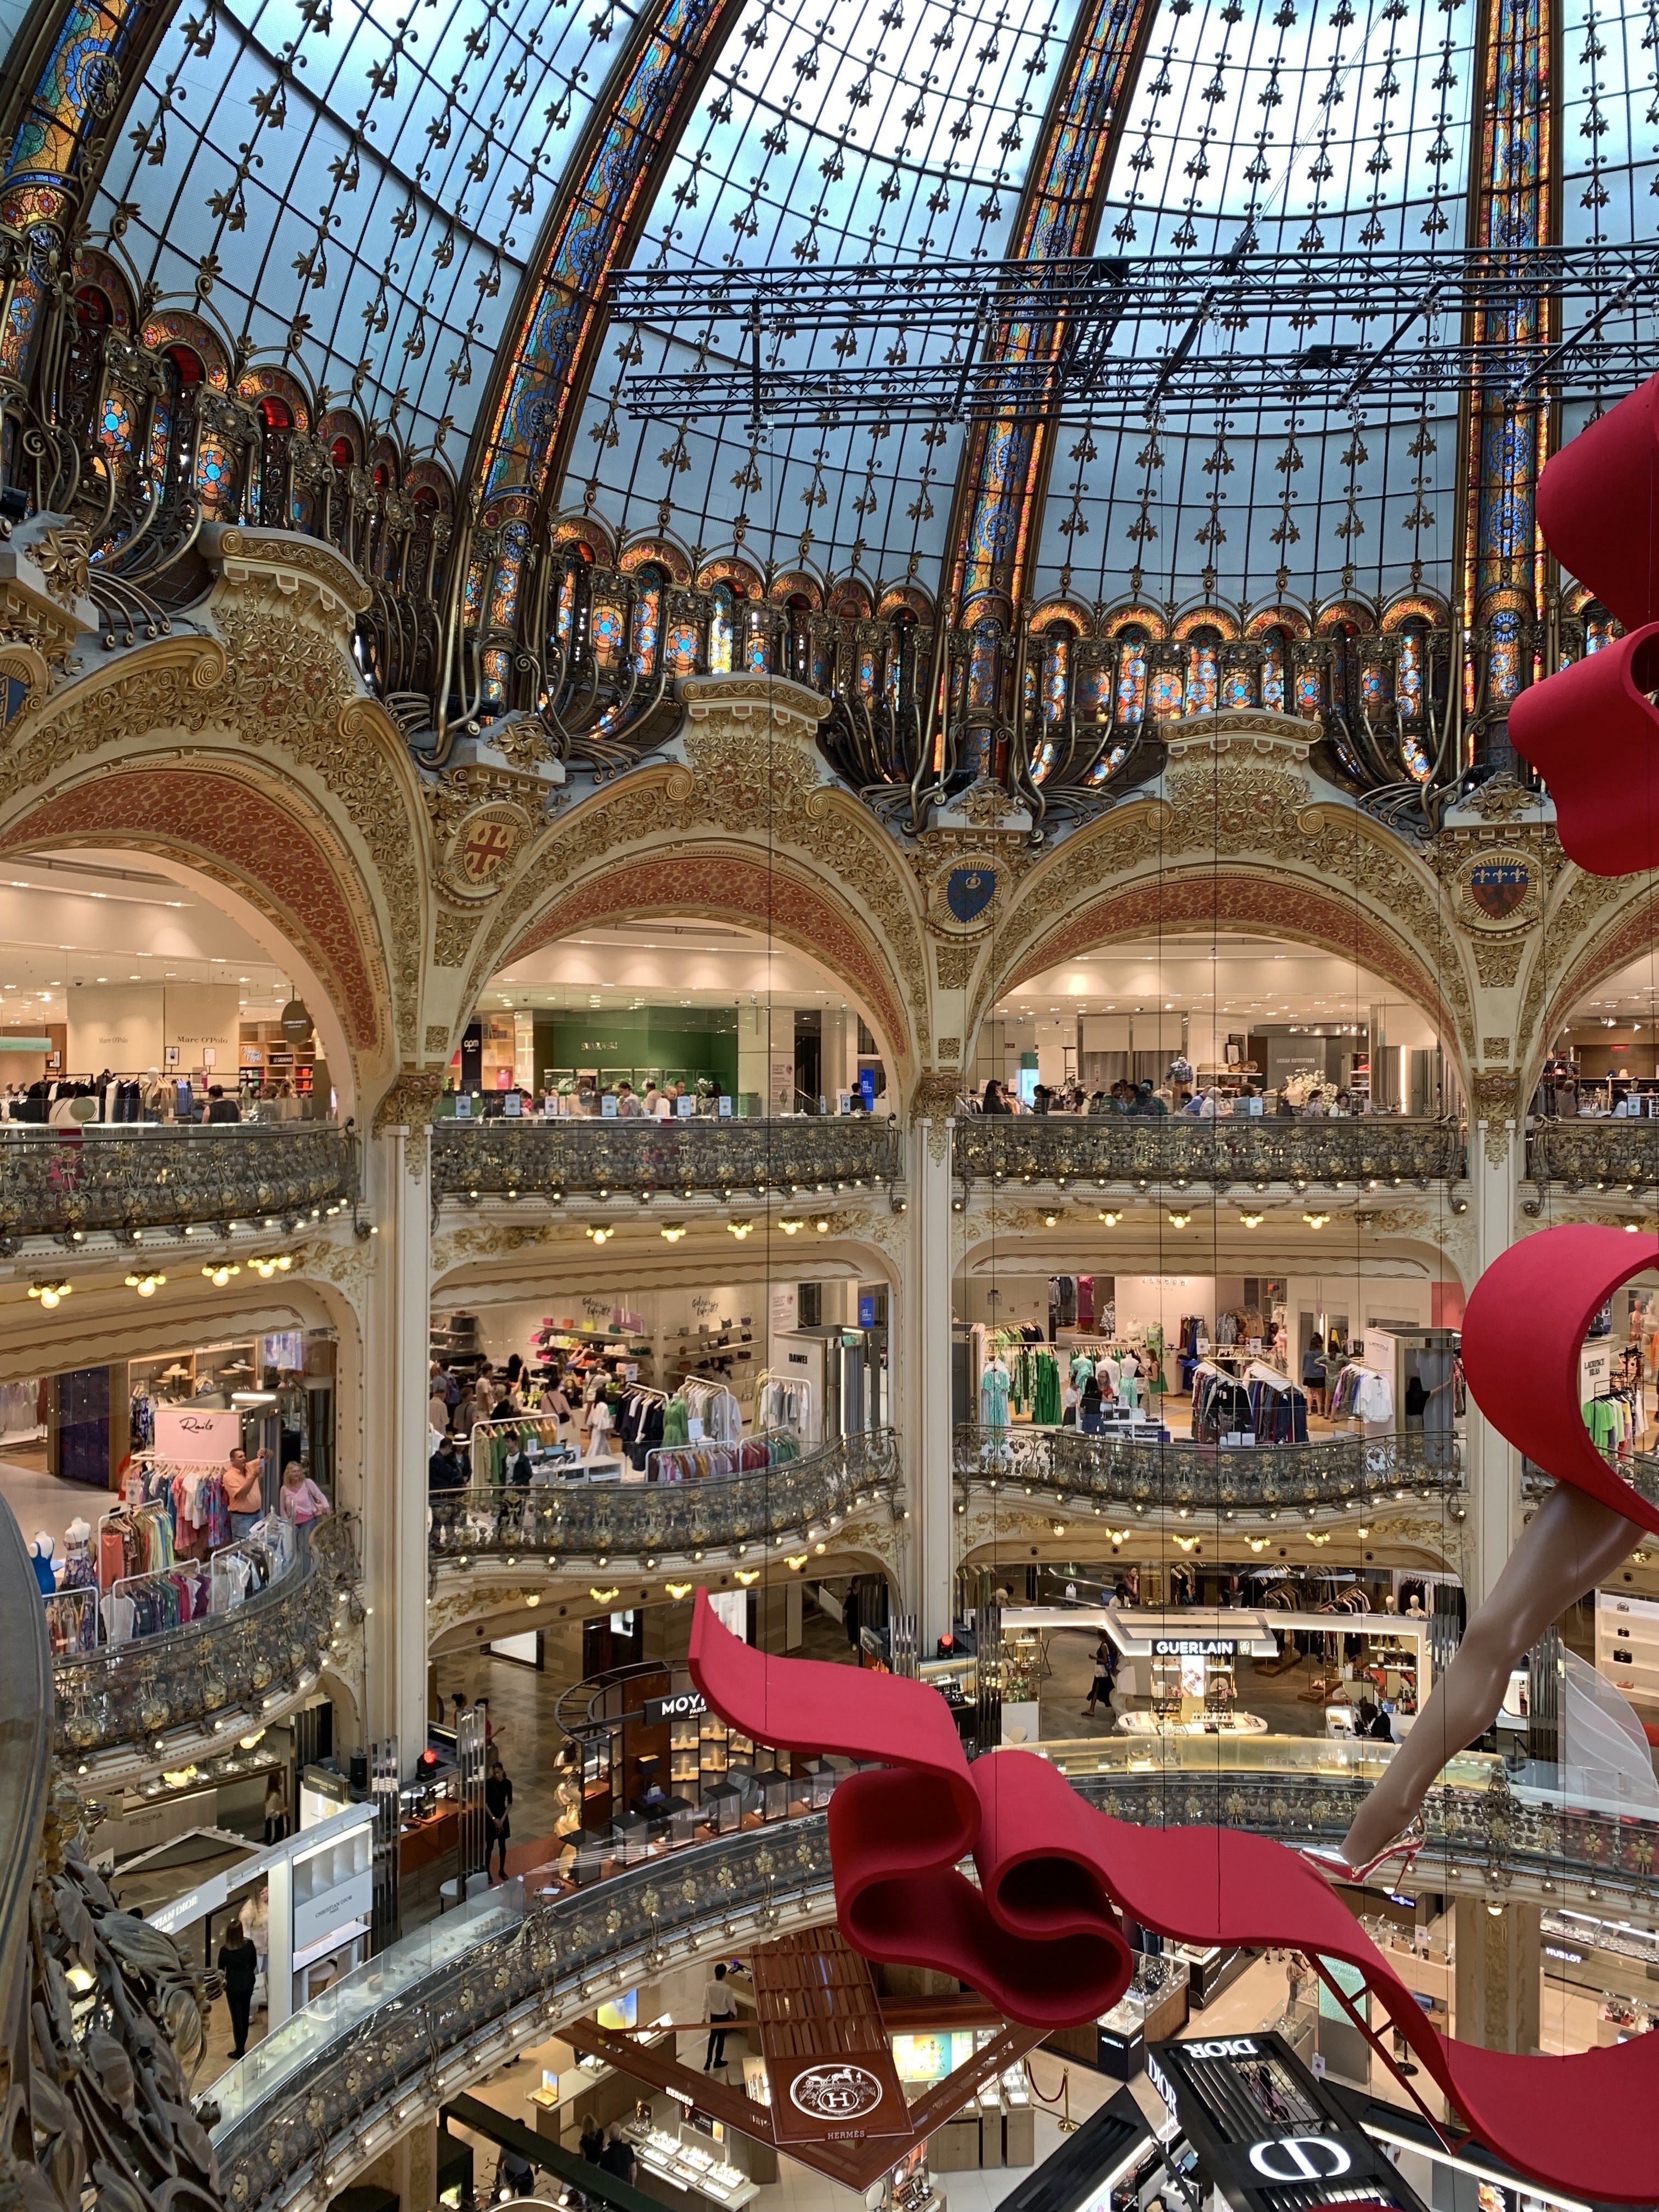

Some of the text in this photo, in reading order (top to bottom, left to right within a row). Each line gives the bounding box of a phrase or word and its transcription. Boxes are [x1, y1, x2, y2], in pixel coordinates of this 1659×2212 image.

[464, 1039, 479, 1050] apm
[581, 1042, 618, 1051] SWAROVSKI
[788, 1353, 808, 1364] DAWEI
[179, 1417, 213, 1434] Rails
[1156, 1641, 1234, 1655] GUERLAIN
[689, 1706, 707, 1714] PARIS
[308, 1775, 338, 1792] CHRISTIAN DIOR
[129, 1813, 163, 1826] MESSIKA
[150, 1895, 199, 1929] TIAN DIOR
[315, 1895, 352, 1918] CHRISTIAN DIOR
[1546, 1946, 1582, 1963] HUBLOT
[1183, 2039, 1259, 2058] DIOR
[1148, 2053, 1178, 2119] DIOR
[826, 2092, 851, 2108] H
